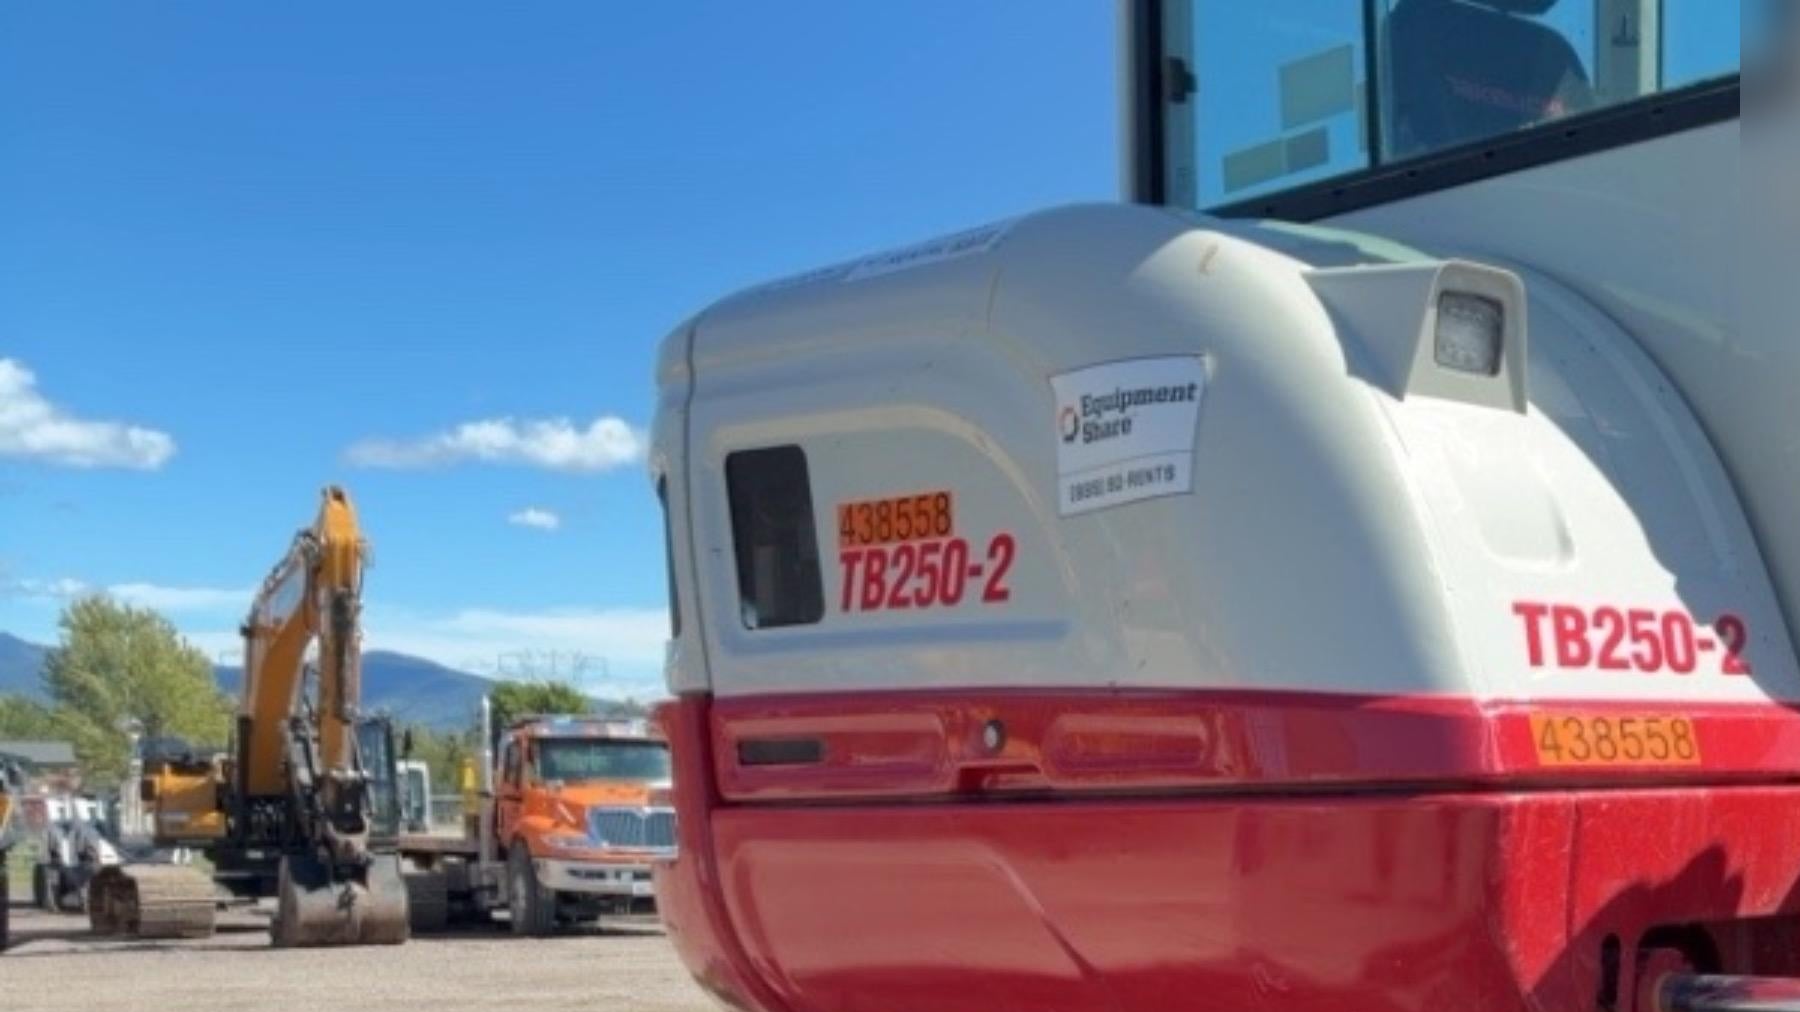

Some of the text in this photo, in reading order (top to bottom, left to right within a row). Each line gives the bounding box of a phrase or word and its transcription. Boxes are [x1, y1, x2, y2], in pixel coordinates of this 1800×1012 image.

[1080, 382, 1197, 418] Equipment
[1082, 417, 1132, 444] Share
[840, 492, 951, 545] 438558
[840, 533, 1015, 612] TB250-2
[1512, 602, 1753, 675] TB250-2
[1540, 715, 1696, 761] 438558
